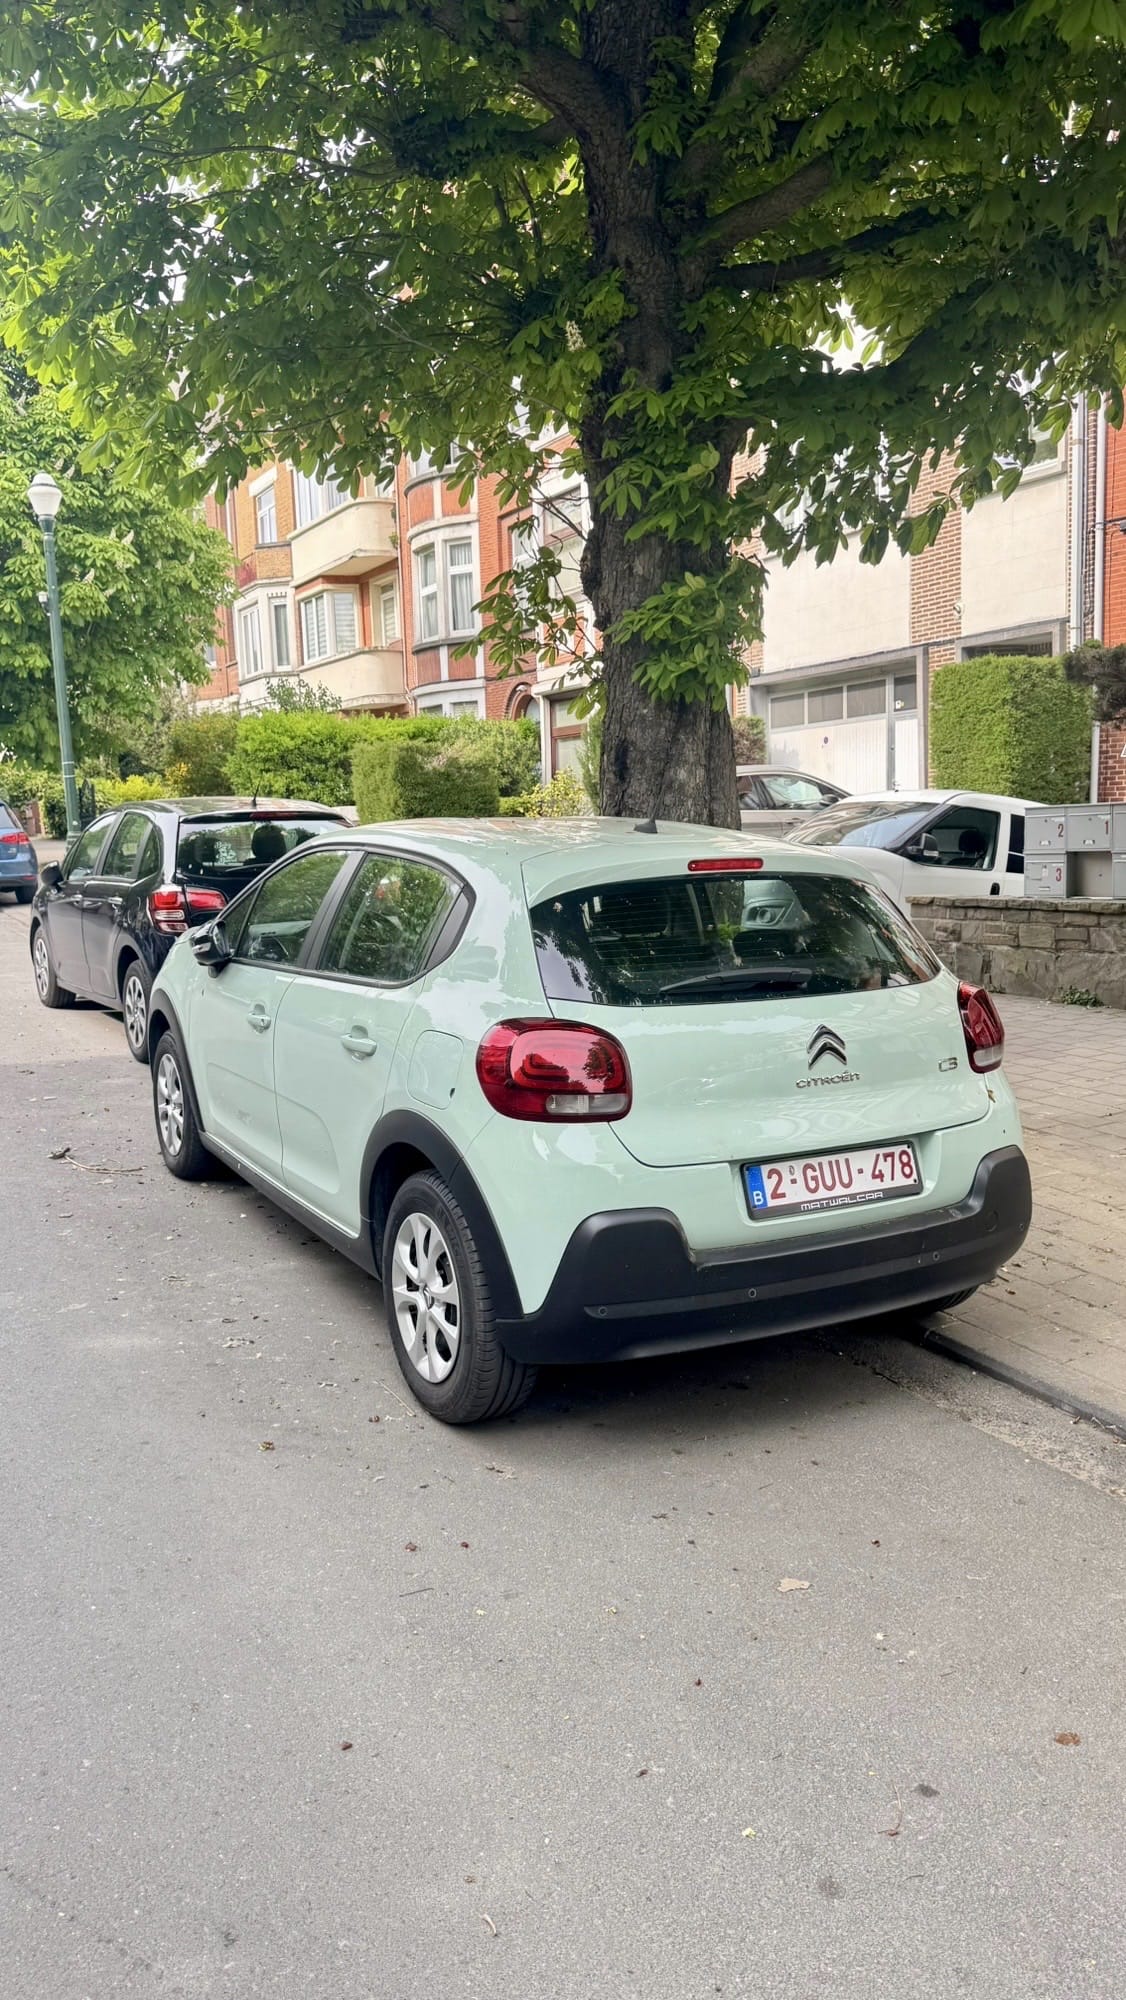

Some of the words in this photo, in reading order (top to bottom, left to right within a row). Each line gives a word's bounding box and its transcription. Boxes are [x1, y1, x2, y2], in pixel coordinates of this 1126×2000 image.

[1057, 823, 1064, 838] 2
[1104, 820, 1109, 835] 1
[1055, 867, 1062, 882] 3
[938, 1056, 958, 1072] C3
[767, 1150, 913, 1200] 2-GUU-478
[753, 1191, 764, 1205] B
